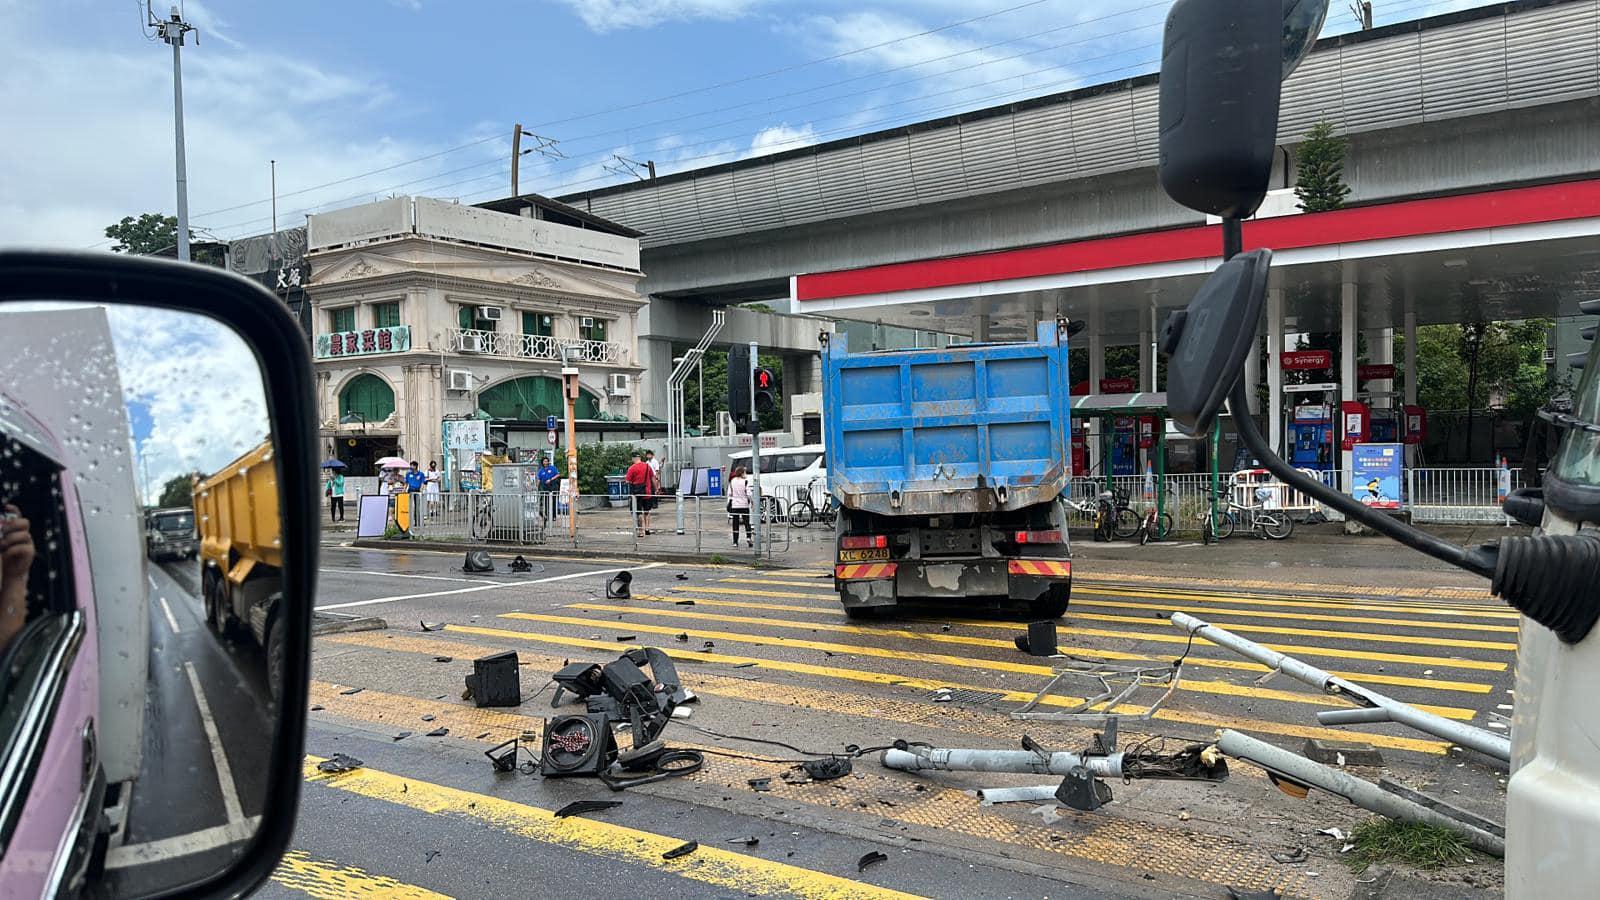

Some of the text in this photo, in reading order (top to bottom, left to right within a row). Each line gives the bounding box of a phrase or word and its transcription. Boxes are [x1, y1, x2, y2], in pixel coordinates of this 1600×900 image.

[330, 329, 392, 355] 農家菜館
[1294, 357, 1325, 365] Synergy
[841, 551, 856, 560] XL
